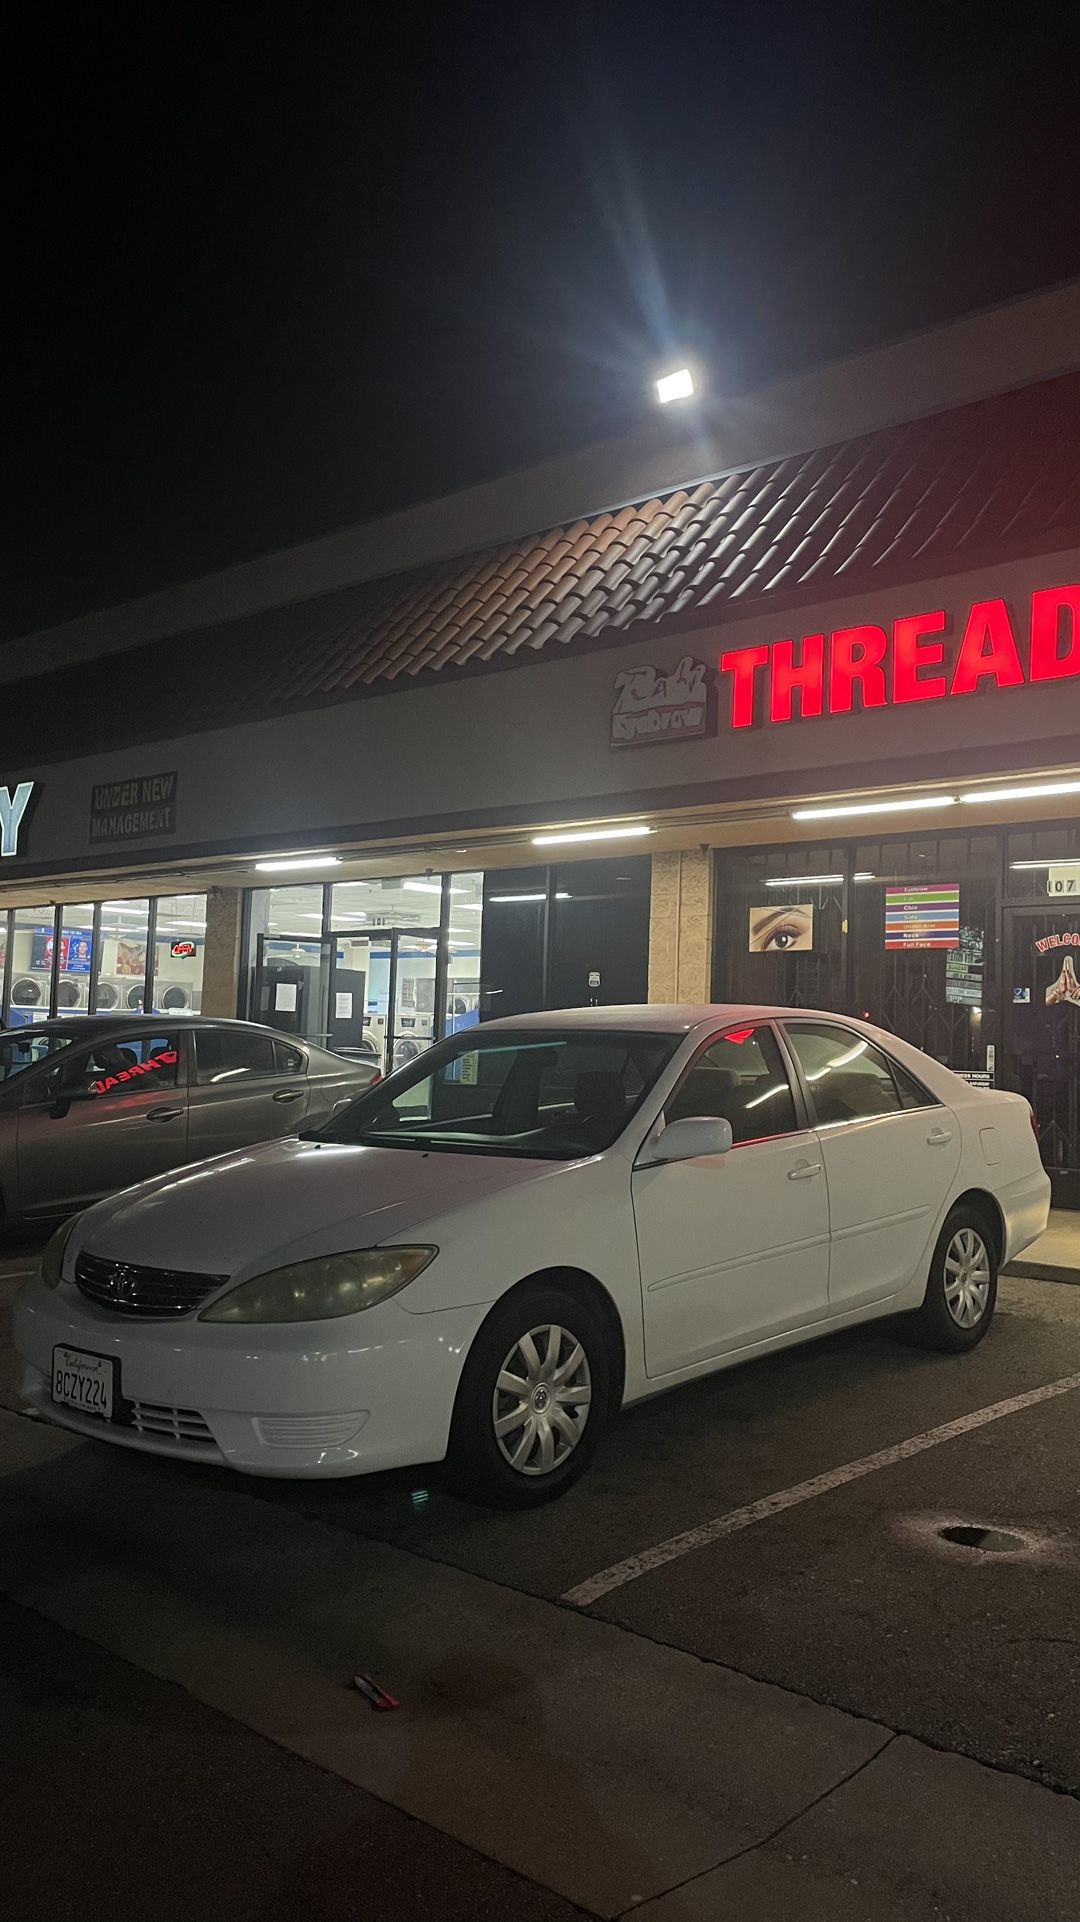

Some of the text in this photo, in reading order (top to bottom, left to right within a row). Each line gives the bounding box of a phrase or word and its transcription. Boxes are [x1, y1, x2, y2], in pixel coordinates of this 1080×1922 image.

[721, 584, 1080, 728] THREAD
[95, 775, 174, 809] UNDER NEW
[0, 781, 34, 856] Y
[92, 807, 170, 837] MANAGEMENT
[173, 943, 193, 955] OPEN
[56, 1370, 107, 1408] 8CZY224
